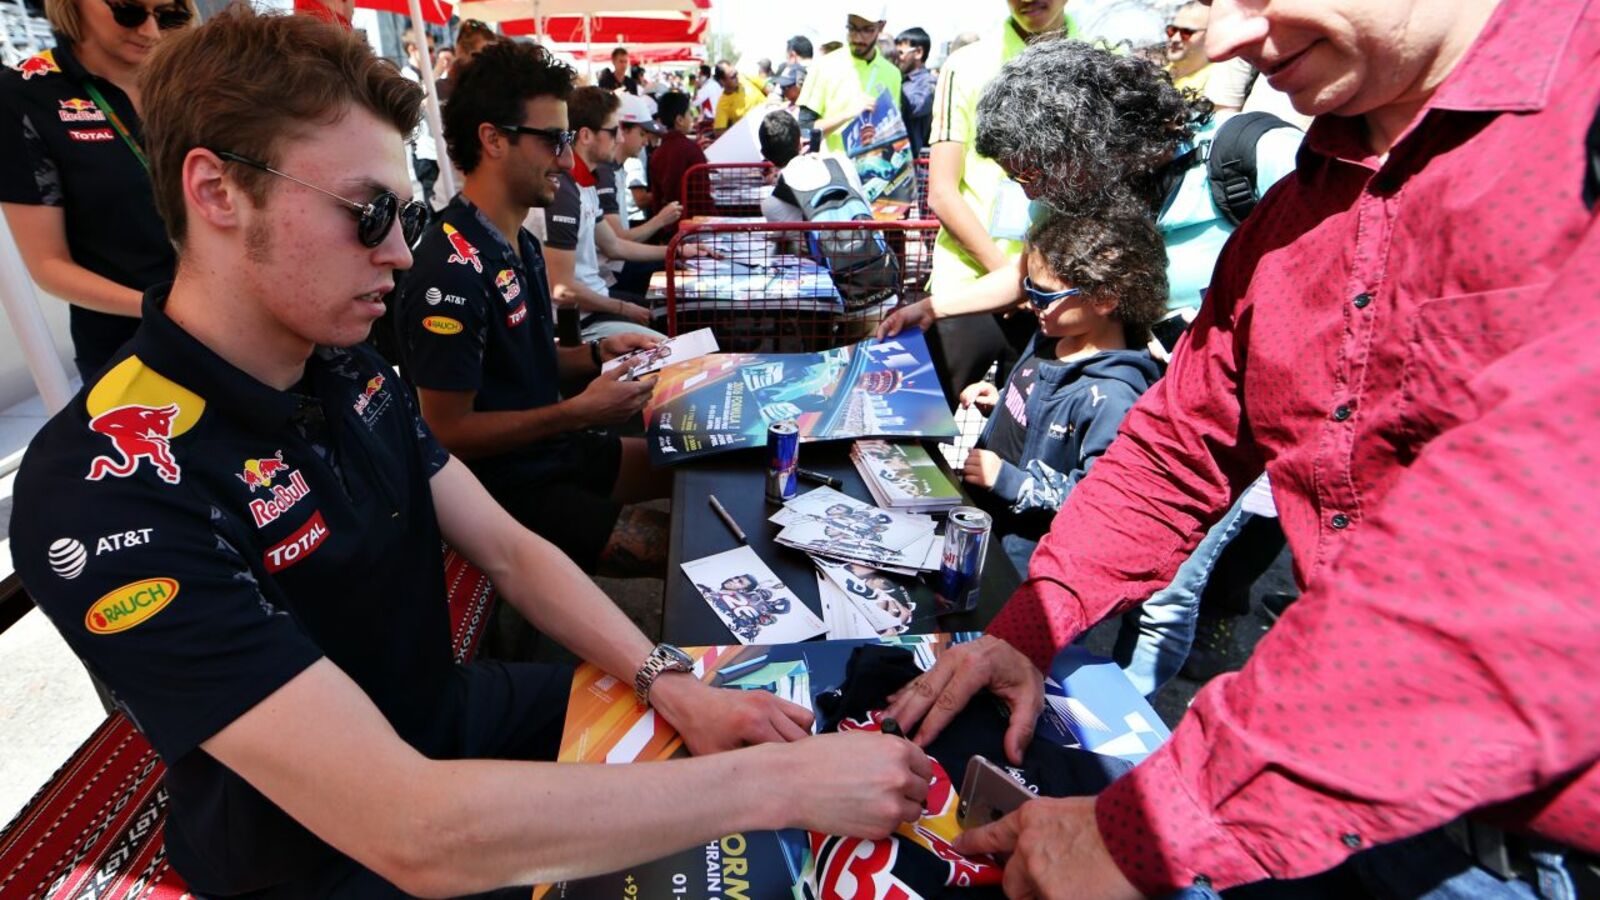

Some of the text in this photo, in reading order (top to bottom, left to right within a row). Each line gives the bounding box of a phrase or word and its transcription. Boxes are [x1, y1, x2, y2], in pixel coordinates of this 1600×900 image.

[69, 130, 115, 140] TOTAL
[444, 294, 468, 306] AT&T
[95, 527, 154, 556] AT&T
[267, 522, 326, 567] TOTAL
[102, 583, 167, 623] RAUCH
[705, 839, 721, 892] HRAIN
[720, 832, 751, 900] ORM
[671, 873, 687, 900] 01-
